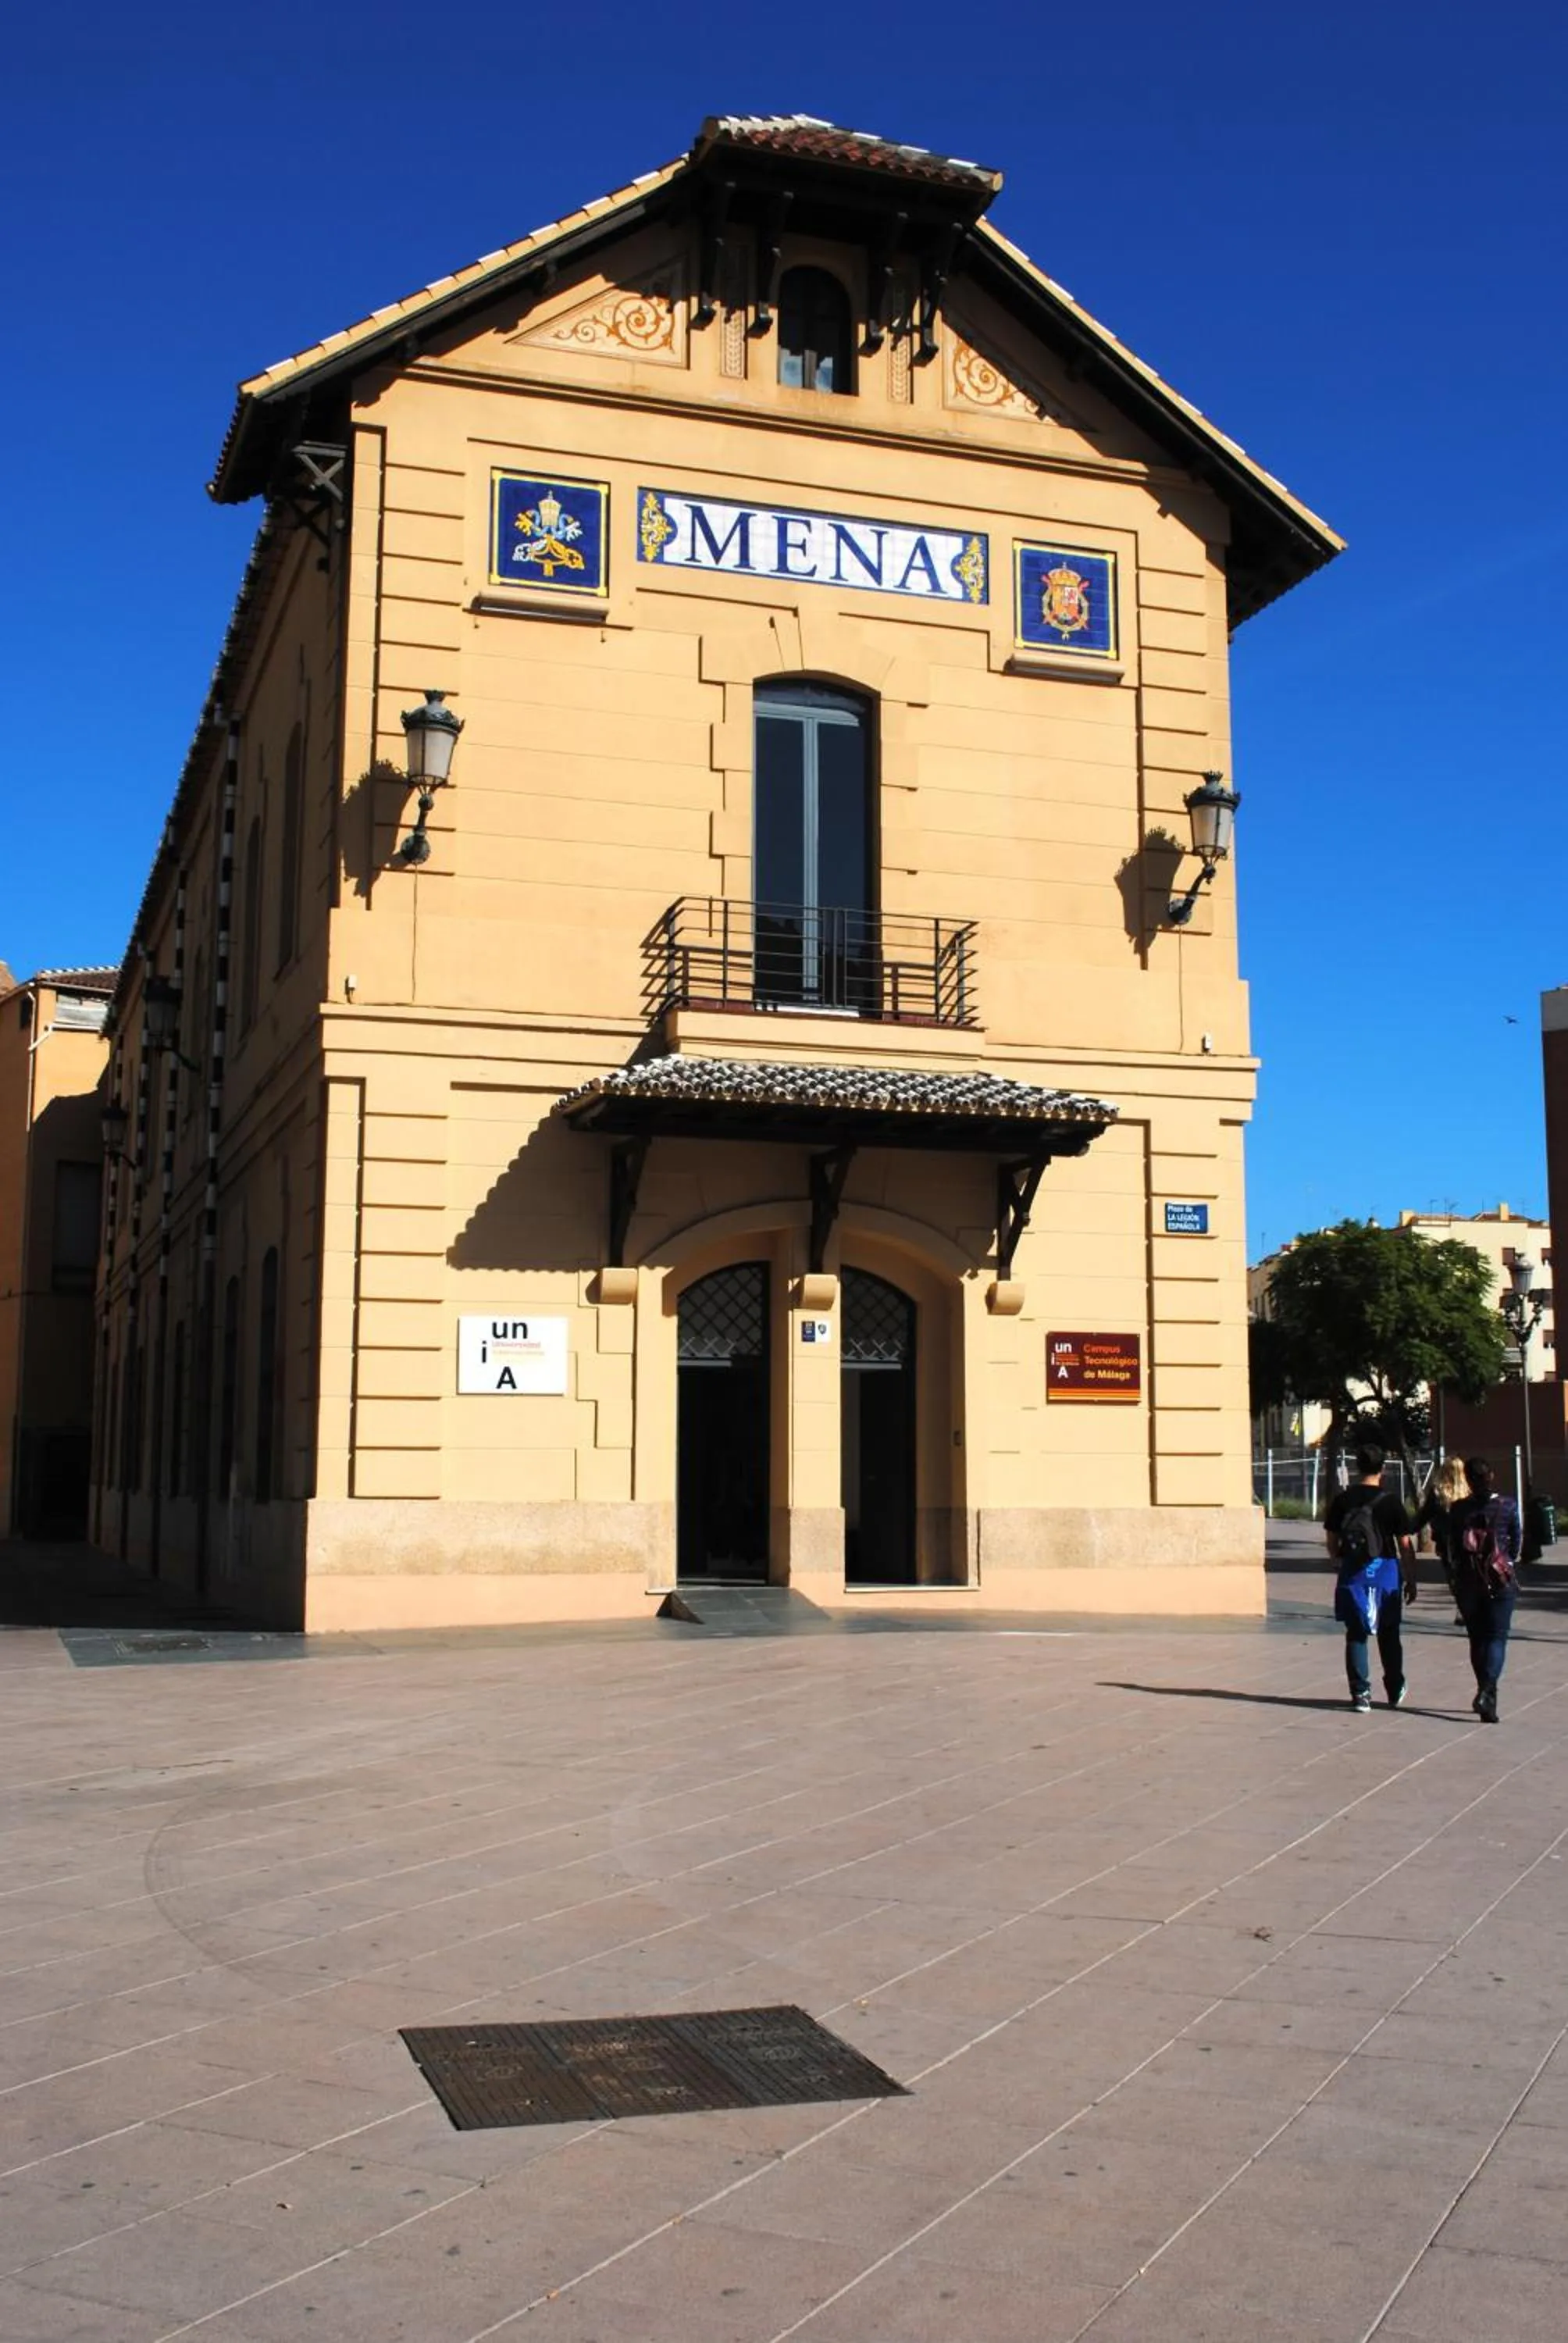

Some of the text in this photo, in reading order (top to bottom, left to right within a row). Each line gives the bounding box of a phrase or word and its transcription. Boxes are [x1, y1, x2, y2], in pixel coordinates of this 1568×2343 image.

[684, 503, 949, 595] MENA
[491, 1321, 529, 1339] un
[1055, 1342, 1072, 1353] un
[1083, 1343, 1121, 1354] Campus
[1084, 1355, 1139, 1368] Tecnológico
[496, 1365, 517, 1389] A
[1083, 1369, 1131, 1381] de Málaga
